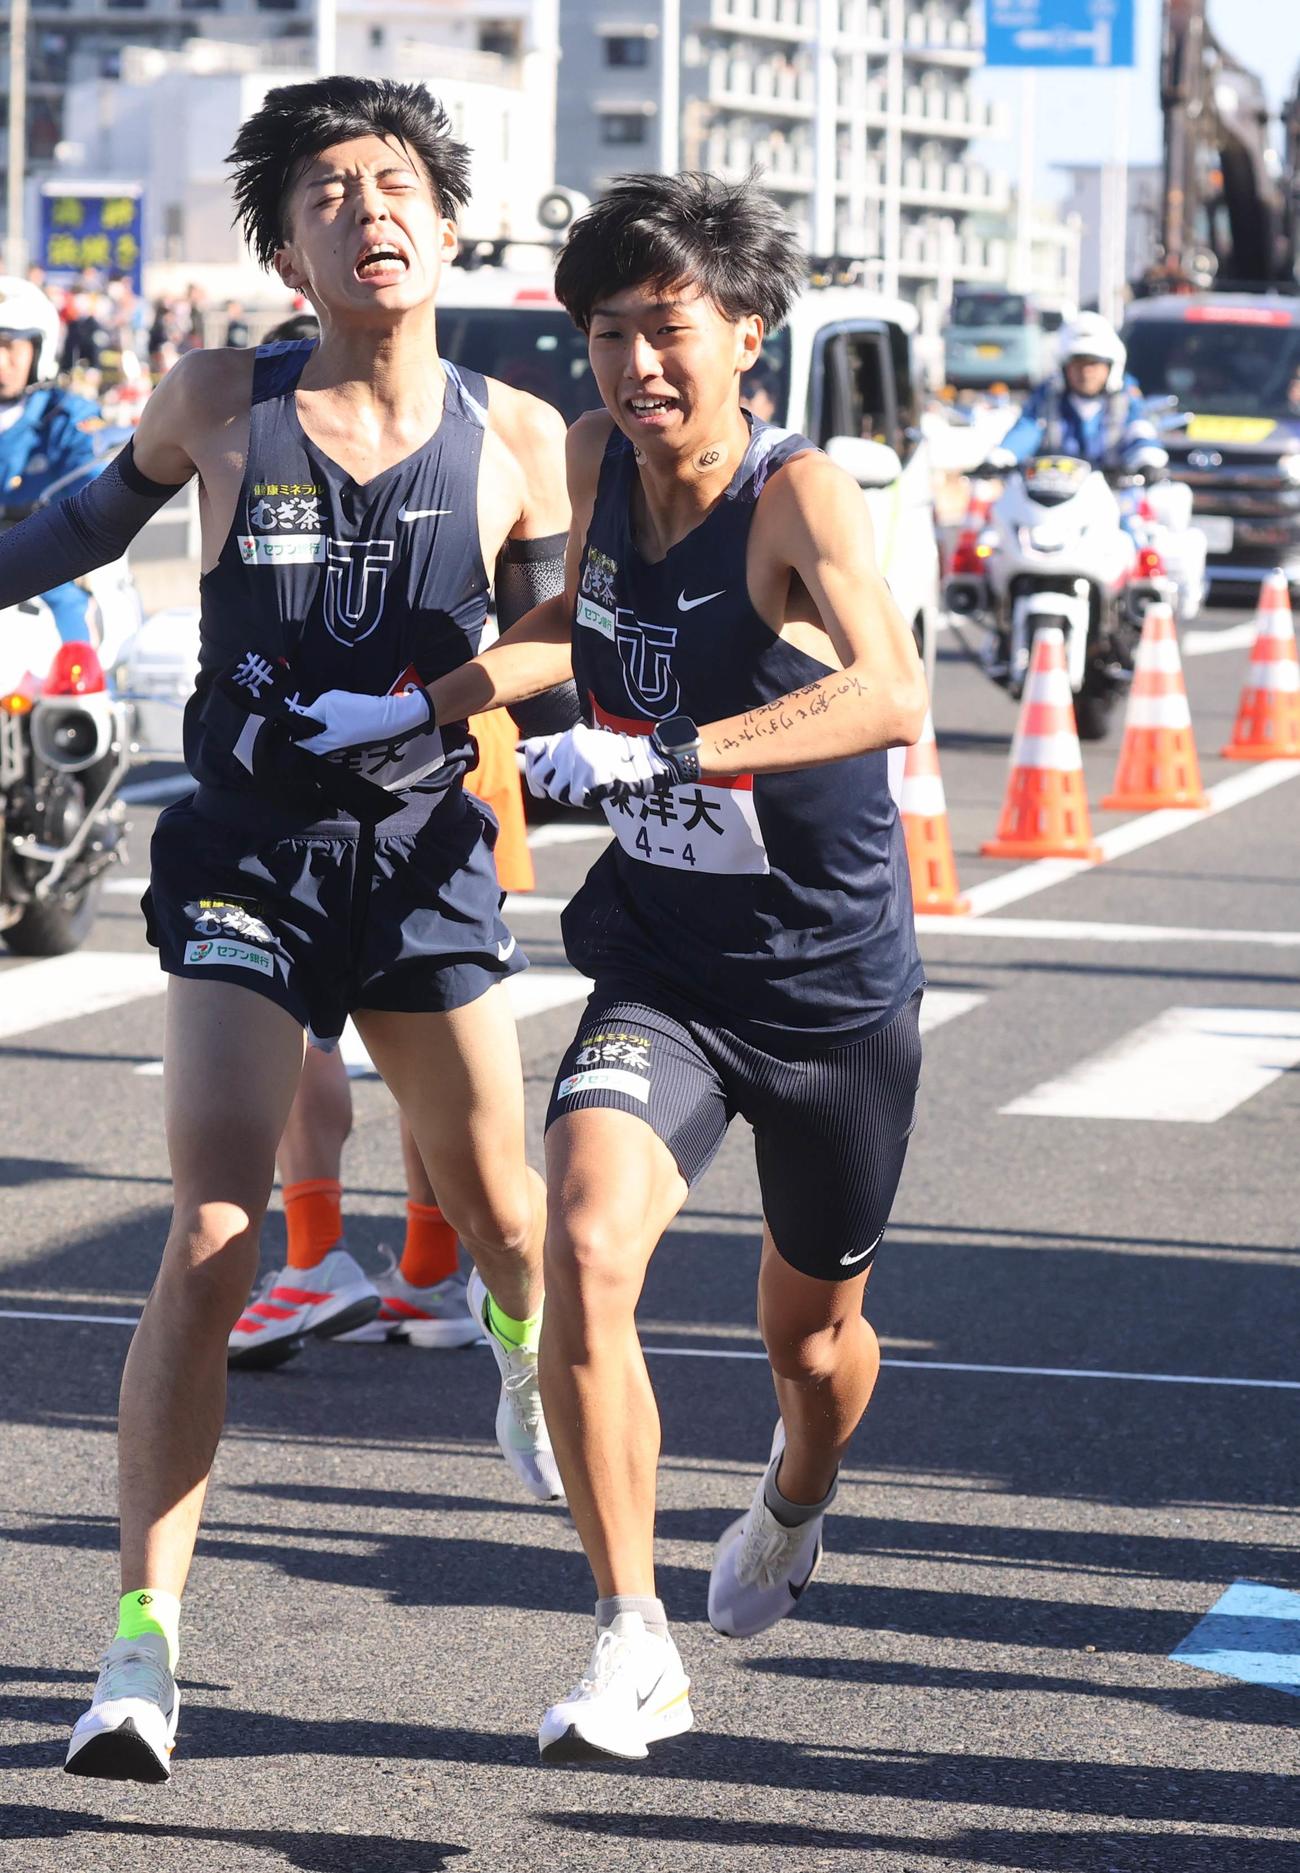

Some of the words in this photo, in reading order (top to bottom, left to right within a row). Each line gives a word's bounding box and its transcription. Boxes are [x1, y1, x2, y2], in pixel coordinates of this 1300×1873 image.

[250, 497, 329, 530] むぎ茶
[635, 825, 697, 866] 4-4
[217, 945, 270, 968] セブン銀行
[576, 1042, 651, 1070] むぎ茶
